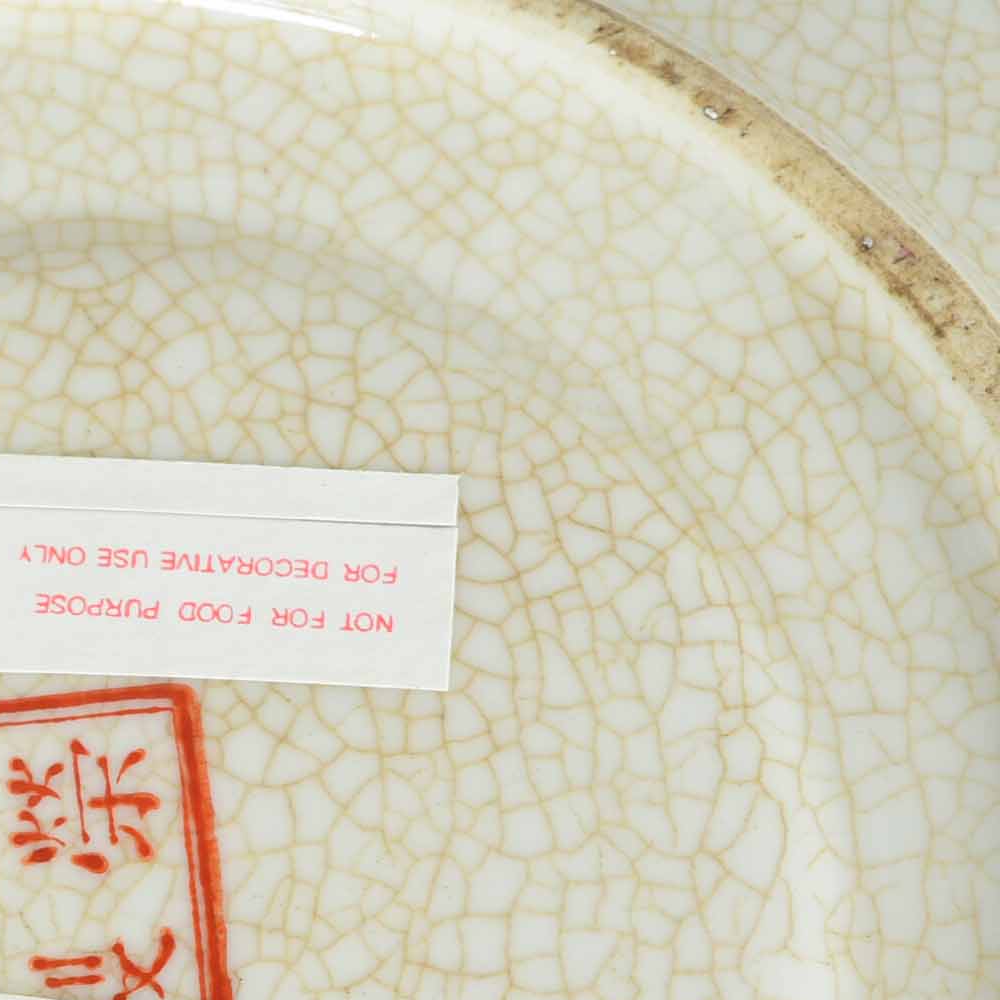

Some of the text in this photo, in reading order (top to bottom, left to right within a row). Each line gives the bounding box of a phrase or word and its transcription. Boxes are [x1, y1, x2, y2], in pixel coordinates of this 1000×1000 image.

[19, 543, 399, 586] FOR DECORATIVE USE ONLY
[34, 593, 396, 634] NOT FOR FOOD PURPOSE
